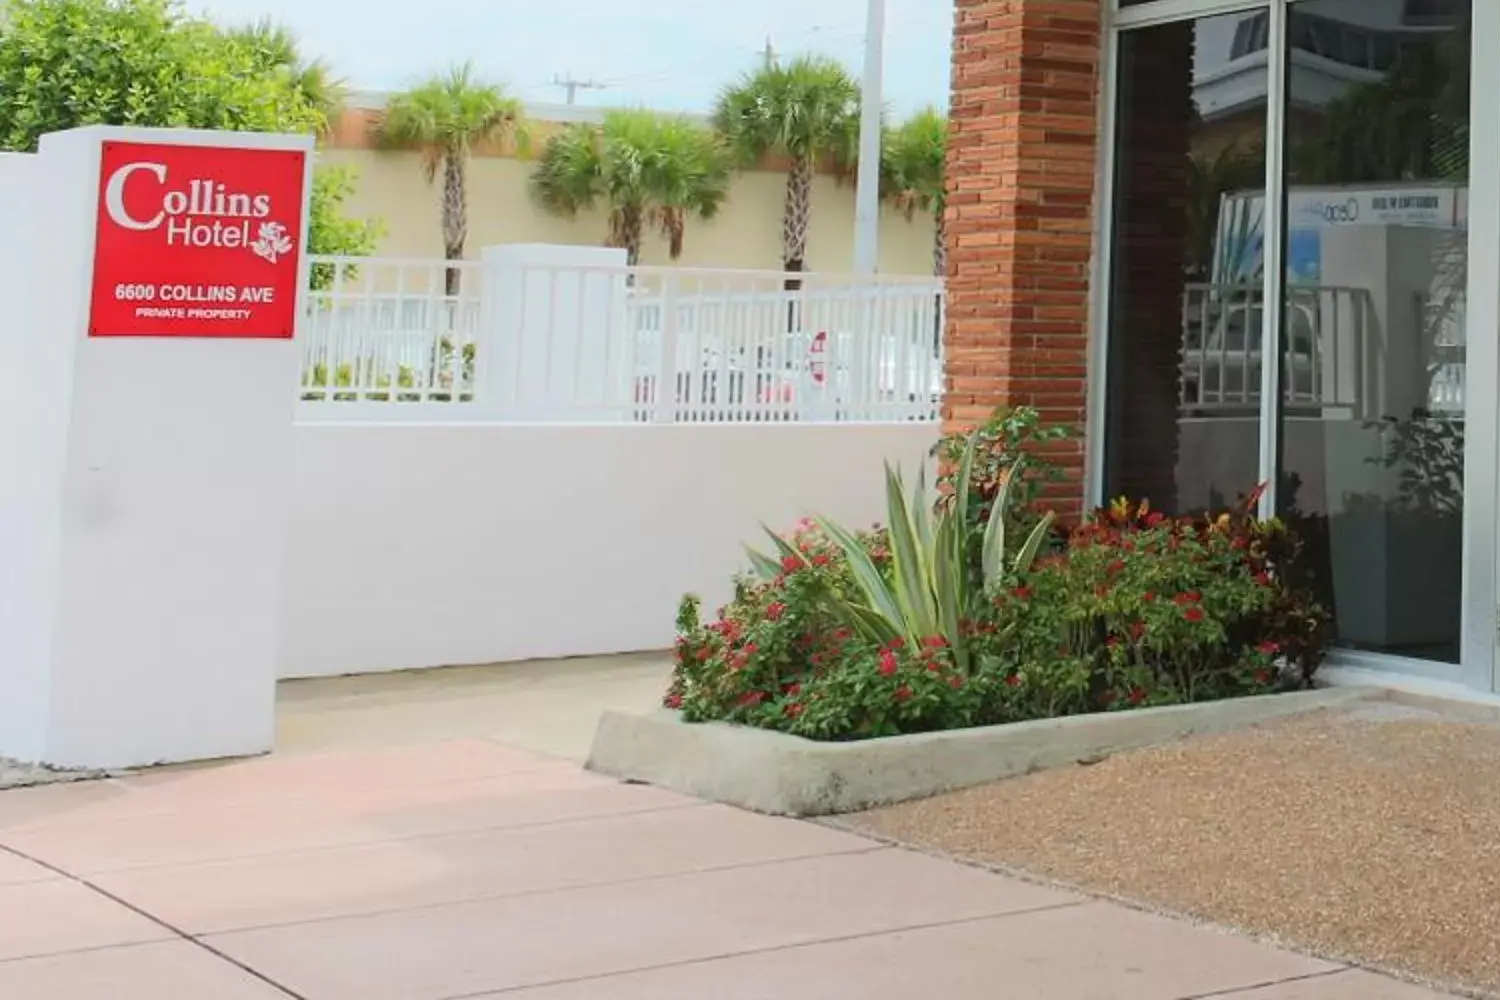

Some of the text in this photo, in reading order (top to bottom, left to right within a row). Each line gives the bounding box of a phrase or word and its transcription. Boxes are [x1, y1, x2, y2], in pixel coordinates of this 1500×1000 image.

[106, 162, 269, 230] Collins
[167, 218, 250, 248] Hotel
[115, 284, 274, 303] 6600 COLLINS AVE
[135, 307, 252, 320] PRIVATE PROPERTY
